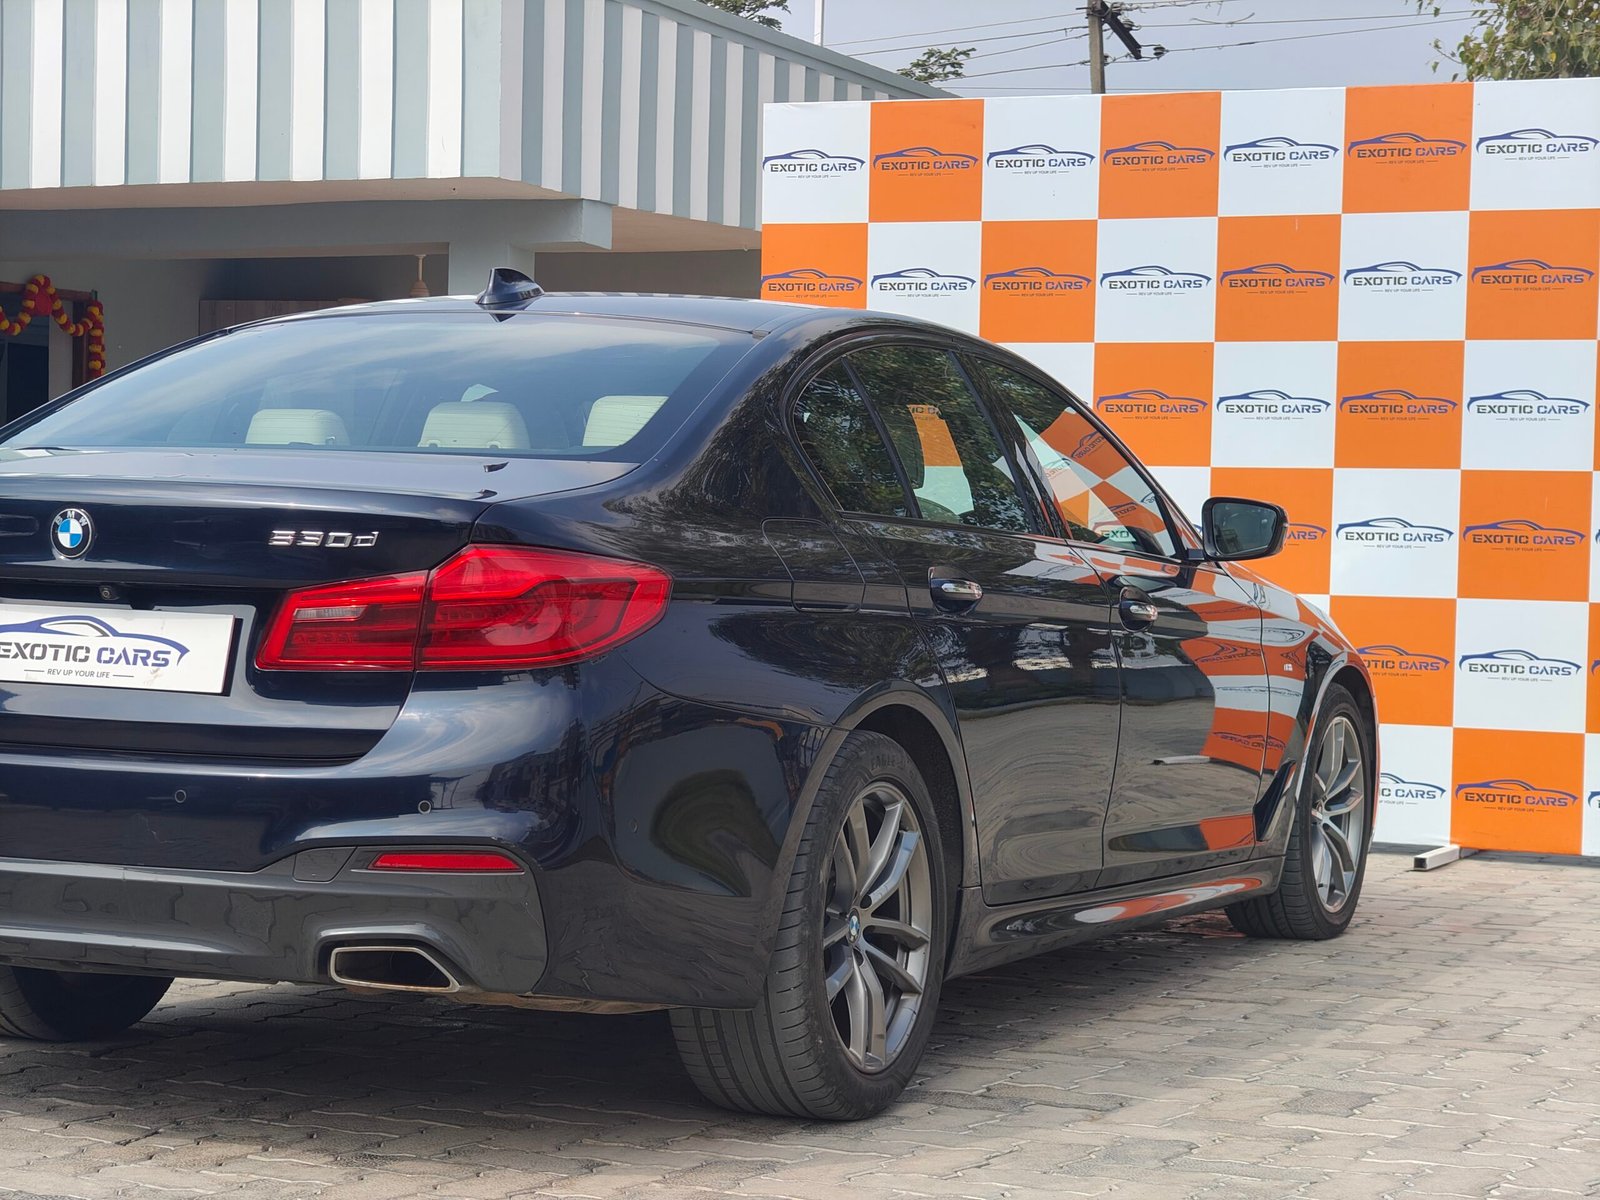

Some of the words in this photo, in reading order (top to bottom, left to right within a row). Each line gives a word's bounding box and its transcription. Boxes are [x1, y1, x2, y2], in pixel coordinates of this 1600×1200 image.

[1357, 148, 1411, 158] EXOTIC
[1416, 146, 1456, 156] CARS
[1485, 144, 1542, 154] EXOTIC
[1546, 143, 1589, 152] CARS
[1112, 156, 1163, 166] EXOTIC
[1167, 154, 1206, 164] CARS
[1232, 152, 1285, 162] EXOTIC
[1290, 150, 1329, 160] CARS
[770, 163, 817, 172] EXOTIC
[821, 163, 856, 171] CARS
[881, 161, 930, 170] EXOTIC
[934, 160, 970, 169] CARS
[995, 159, 1045, 168] EXOTIC
[1049, 158, 1086, 167] CARS
[1229, 278, 1281, 288] EXOTIC
[1286, 278, 1325, 287] CARS
[1353, 276, 1407, 286] EXOTIC
[1412, 276, 1452, 285] CARS
[1481, 275, 1537, 284] EXOTIC
[1542, 274, 1584, 283] CARS
[768, 283, 816, 291] EXOTIC
[879, 282, 927, 291] EXOTIC
[931, 282, 967, 290] CARS
[992, 281, 1042, 290] EXOTIC
[1046, 281, 1083, 289] CARS
[1109, 280, 1160, 289] EXOTIC
[1164, 280, 1202, 288] CARS
[1105, 404, 1156, 412] EXOTIC
[1160, 404, 1198, 413] CARS
[1225, 404, 1278, 413] EXOTIC
[1282, 405, 1321, 413] CARS
[1349, 405, 1403, 413] EXOTIC
[1407, 405, 1448, 413] CARS
[1476, 405, 1533, 414] EXOTIC
[1537, 405, 1579, 414] CARS
[54, 510, 88, 526] BMW
[268, 530, 379, 547] 530d
[1101, 530, 1129, 539] EXO
[1287, 531, 1317, 540] ARS
[1345, 532, 1399, 541] EXOTIC
[1403, 533, 1444, 542] CARS
[1472, 534, 1528, 544] EXOTIC
[1533, 536, 1575, 545] CARS
[0, 642, 90, 662] EXOTIC
[96, 646, 171, 667] CARS
[1399, 661, 1440, 671] CARS
[1468, 663, 1525, 674] EXOTIC
[1529, 666, 1571, 676] CARS
[1395, 789, 1436, 799] CARS
[1465, 792, 1521, 804] EXOTIC
[1526, 796, 1568, 807] CARS
